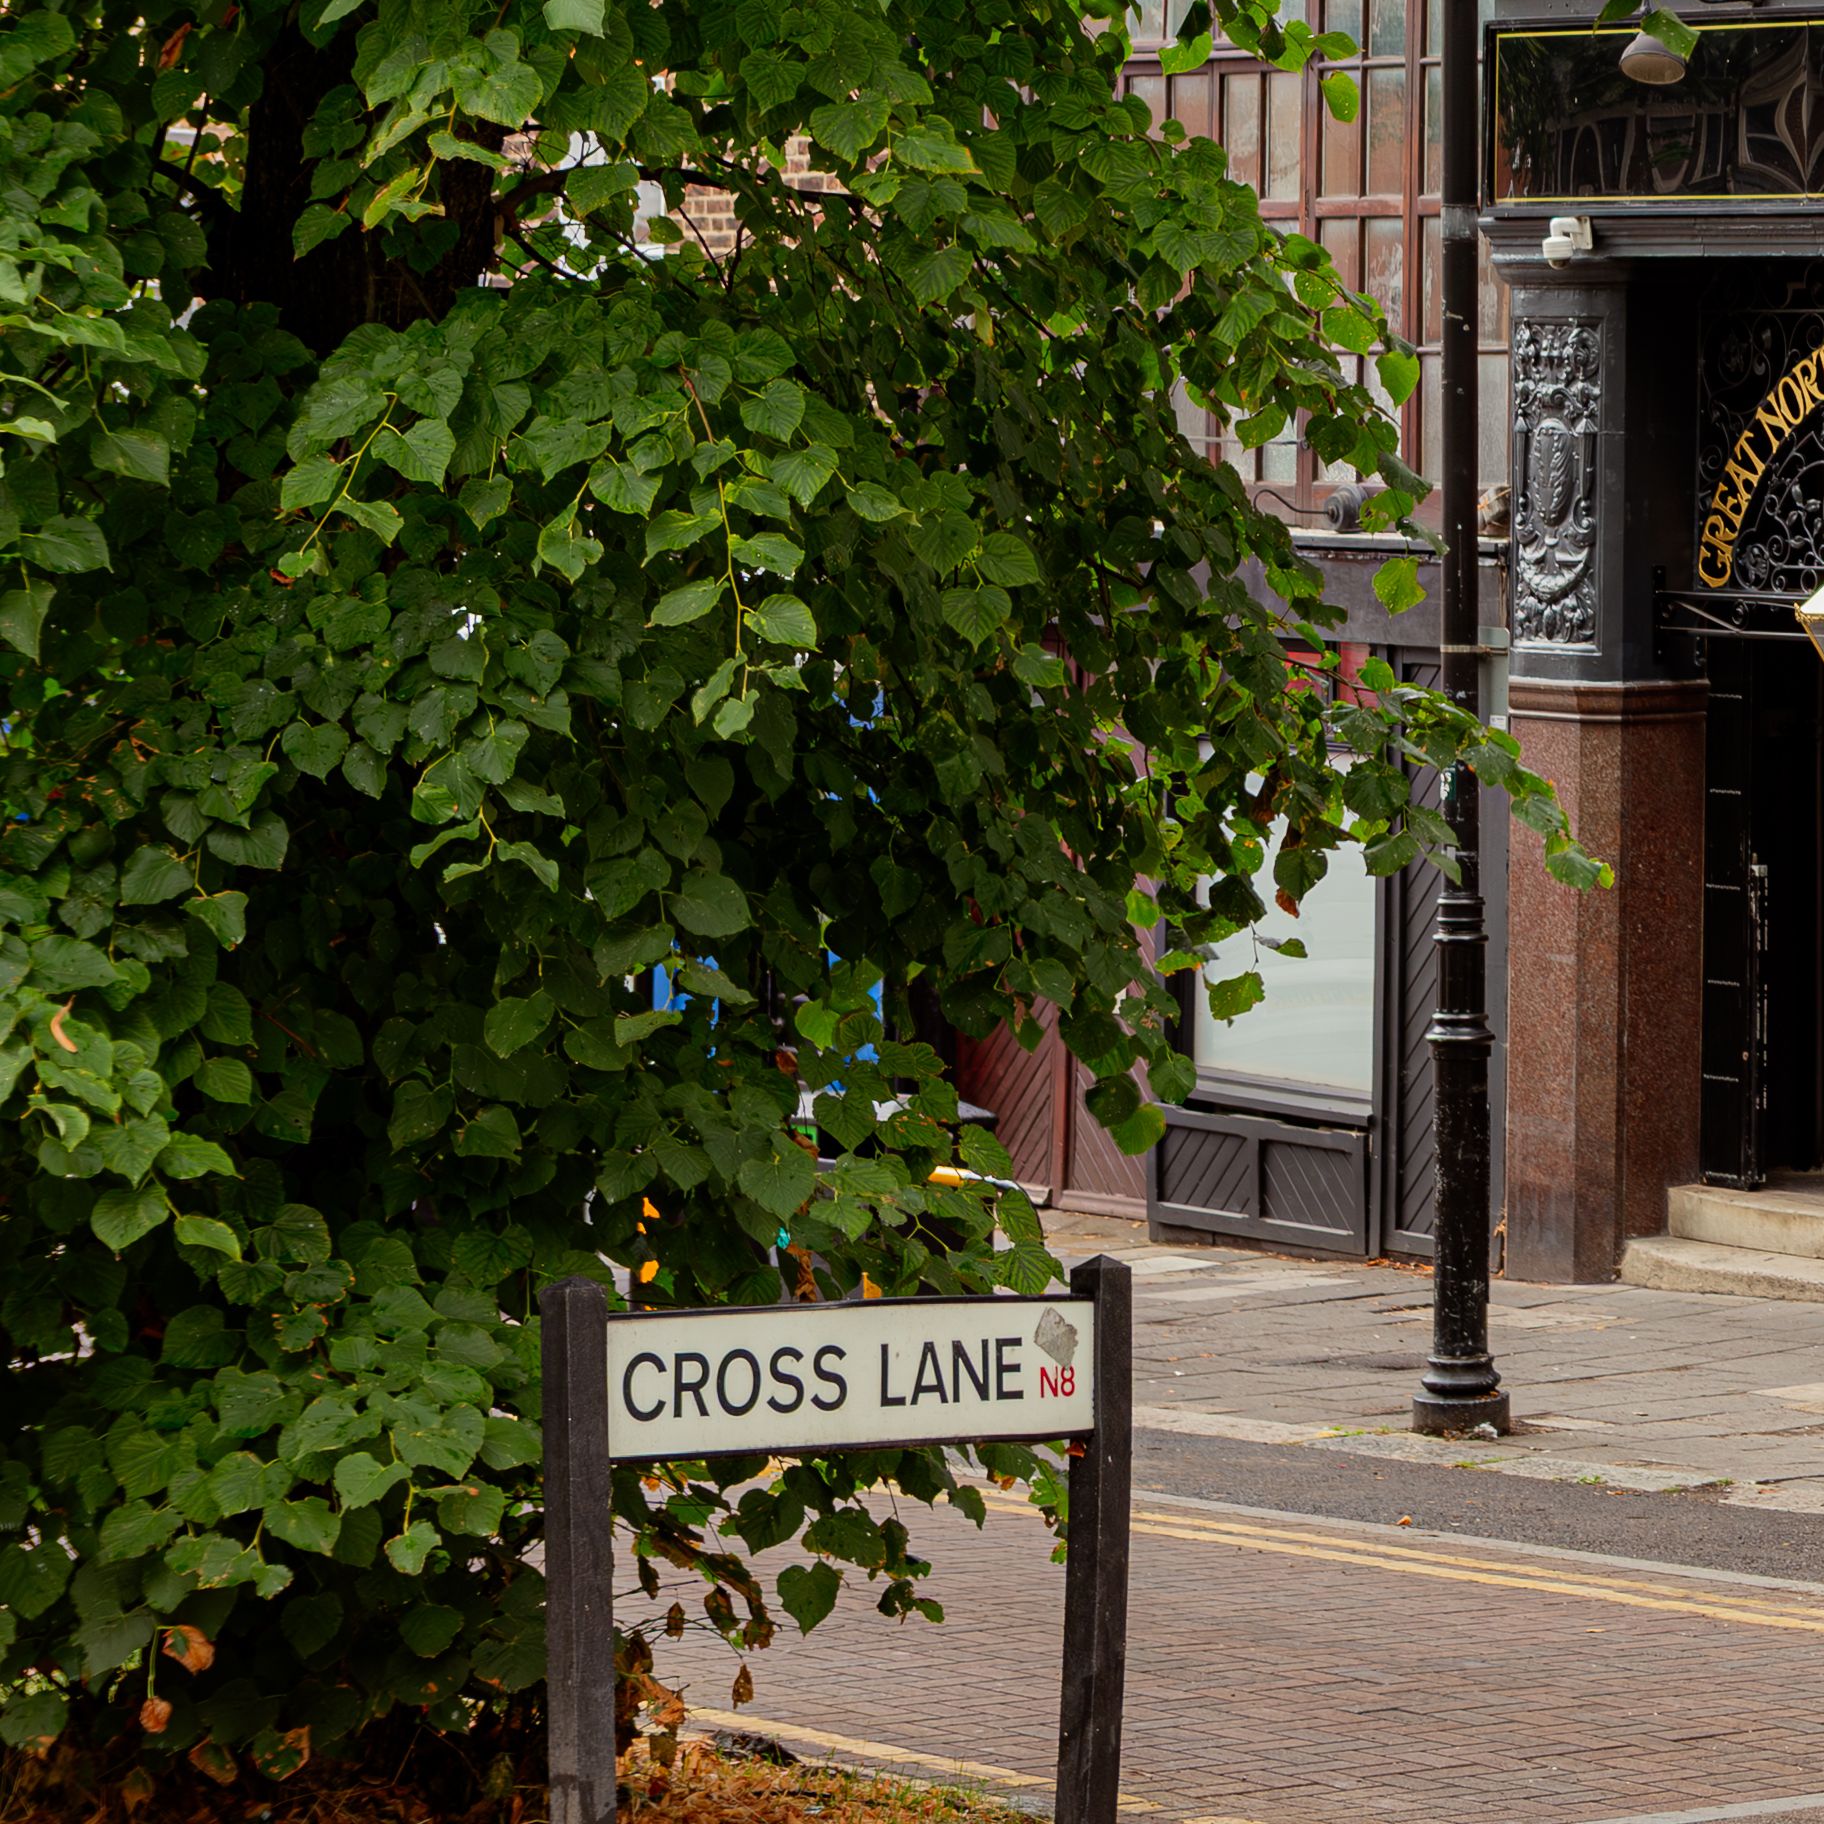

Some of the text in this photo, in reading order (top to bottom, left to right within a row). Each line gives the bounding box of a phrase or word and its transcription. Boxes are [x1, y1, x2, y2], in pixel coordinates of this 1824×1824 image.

[1700, 429, 1766, 588] GREAT
[621, 1336, 1076, 1422] CROSS LANE N8
